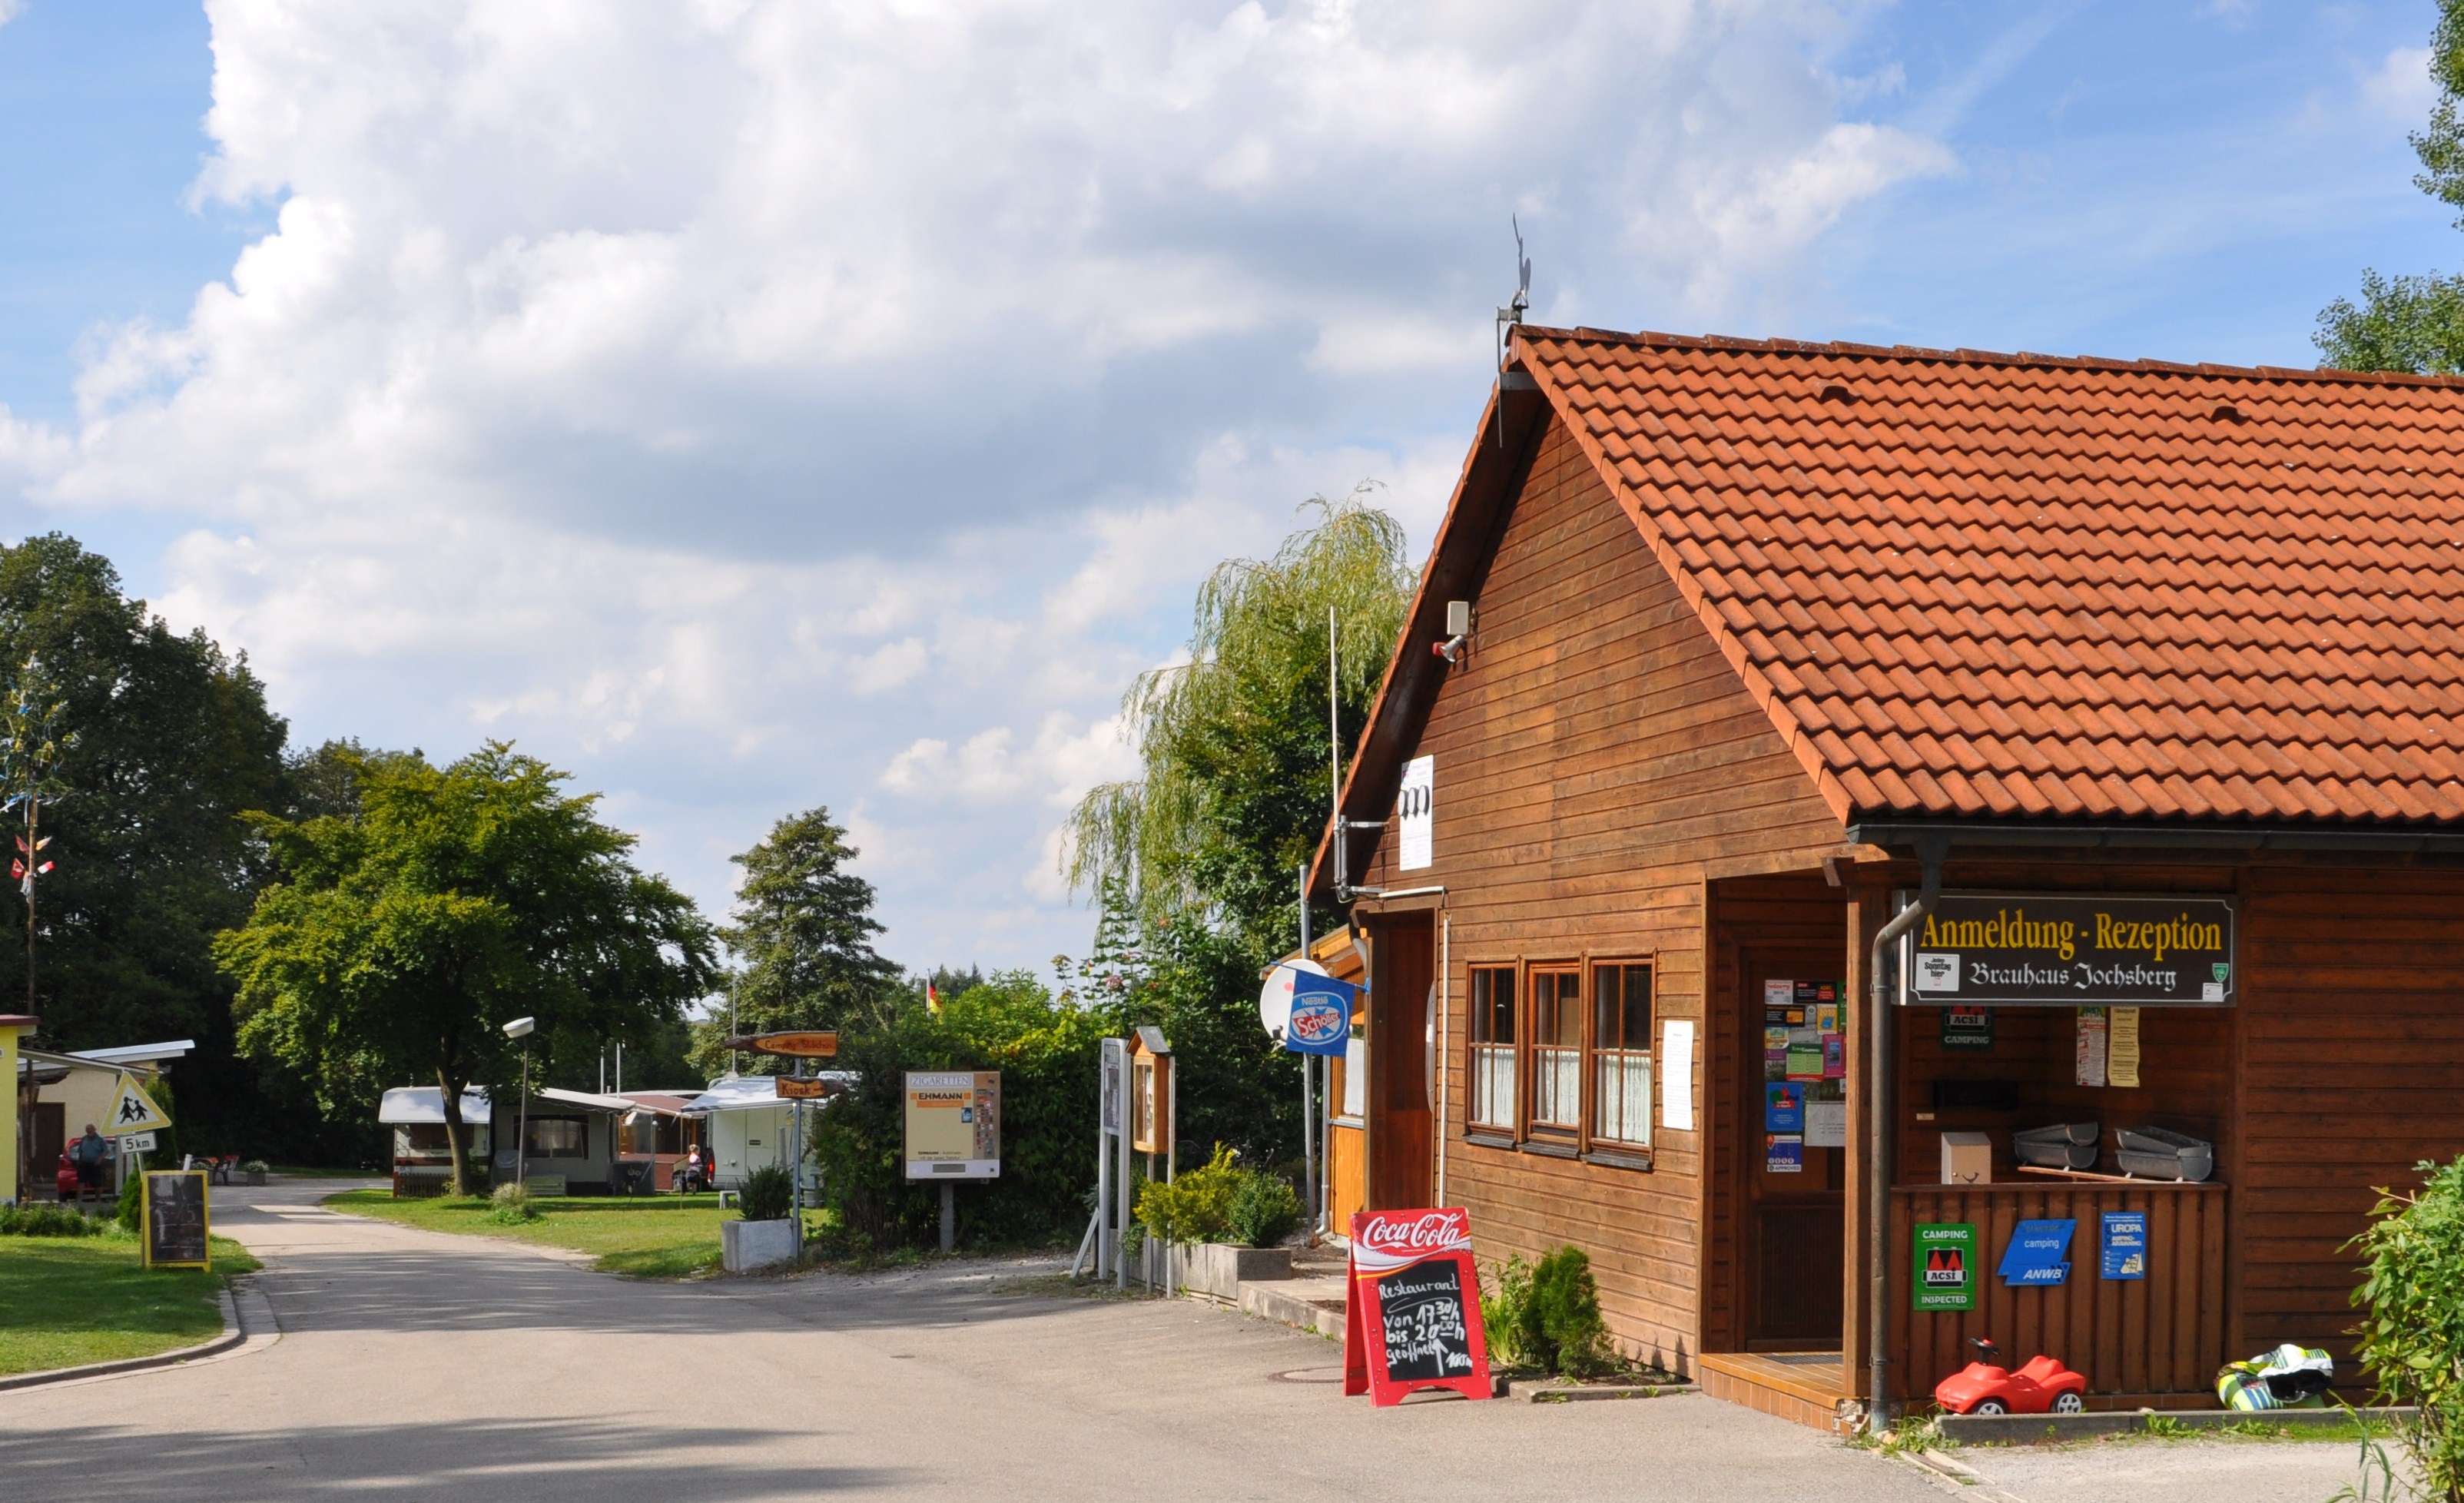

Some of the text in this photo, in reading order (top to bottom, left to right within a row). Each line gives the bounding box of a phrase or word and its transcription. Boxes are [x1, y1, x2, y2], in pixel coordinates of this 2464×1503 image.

[1920, 908, 2074, 961] Anmeldung
[2094, 912, 2222, 961] Rezeption
[1925, 962, 1952, 971] Sonntag
[1968, 962, 2177, 992] Brauhaus Jochsberg
[1297, 1013, 1340, 1037] Schöller
[1944, 1035, 1990, 1044] CAMPING
[913, 1076, 968, 1085] ZIGARETTEN
[781, 1082, 811, 1096] Kiosk
[918, 1092, 963, 1100] EHMANN
[125, 1137, 150, 1150] 5 km
[1922, 1230, 1968, 1239] CAMPING
[2024, 1238, 2059, 1249] camping
[2022, 1269, 2063, 1279] ANWB
[1378, 1273, 1461, 1300] Restaurant
[1922, 1296, 1968, 1304] INSPECTED
[1385, 1329, 1408, 1344] bis
